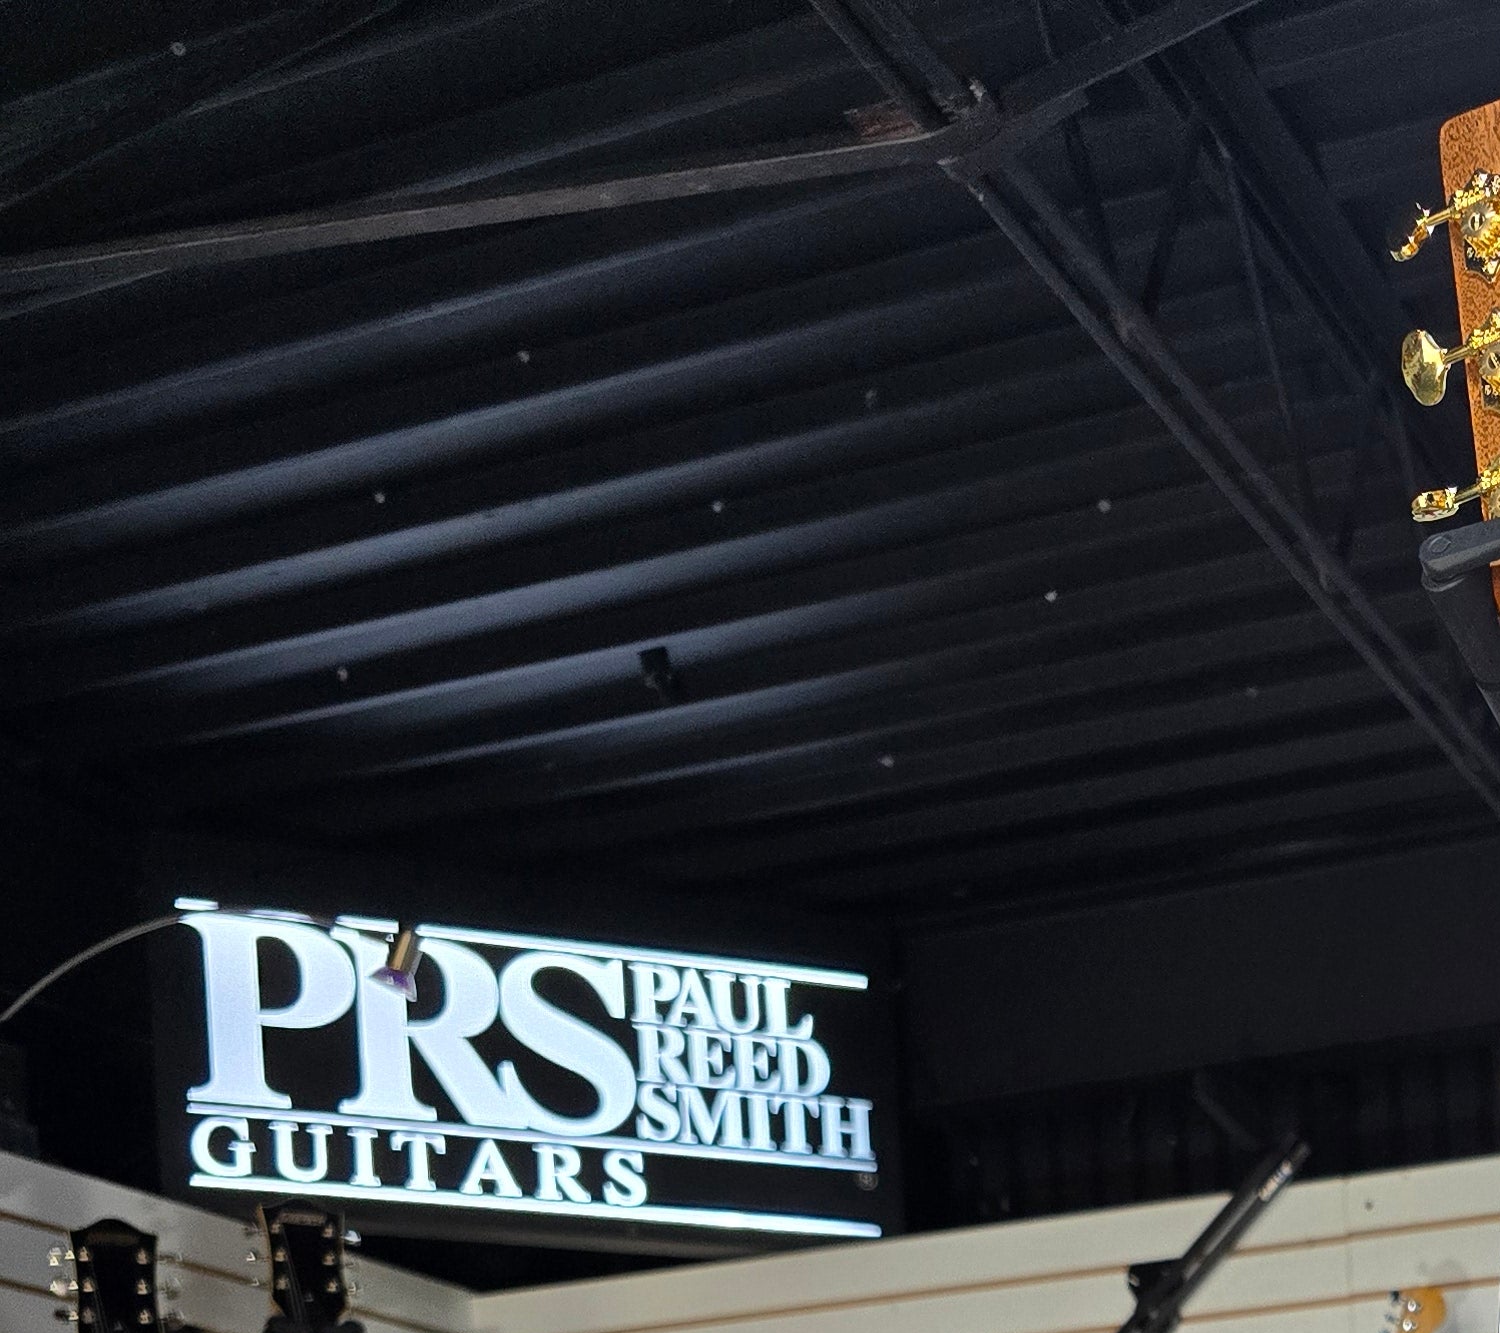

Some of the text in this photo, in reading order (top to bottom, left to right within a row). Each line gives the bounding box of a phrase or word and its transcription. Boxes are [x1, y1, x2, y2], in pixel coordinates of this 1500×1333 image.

[179, 911, 638, 1138] PRS
[628, 962, 815, 1040] PAUL
[631, 1020, 832, 1099] REED
[190, 1116, 649, 1208] GUITARS
[636, 1081, 876, 1162] SMITH
